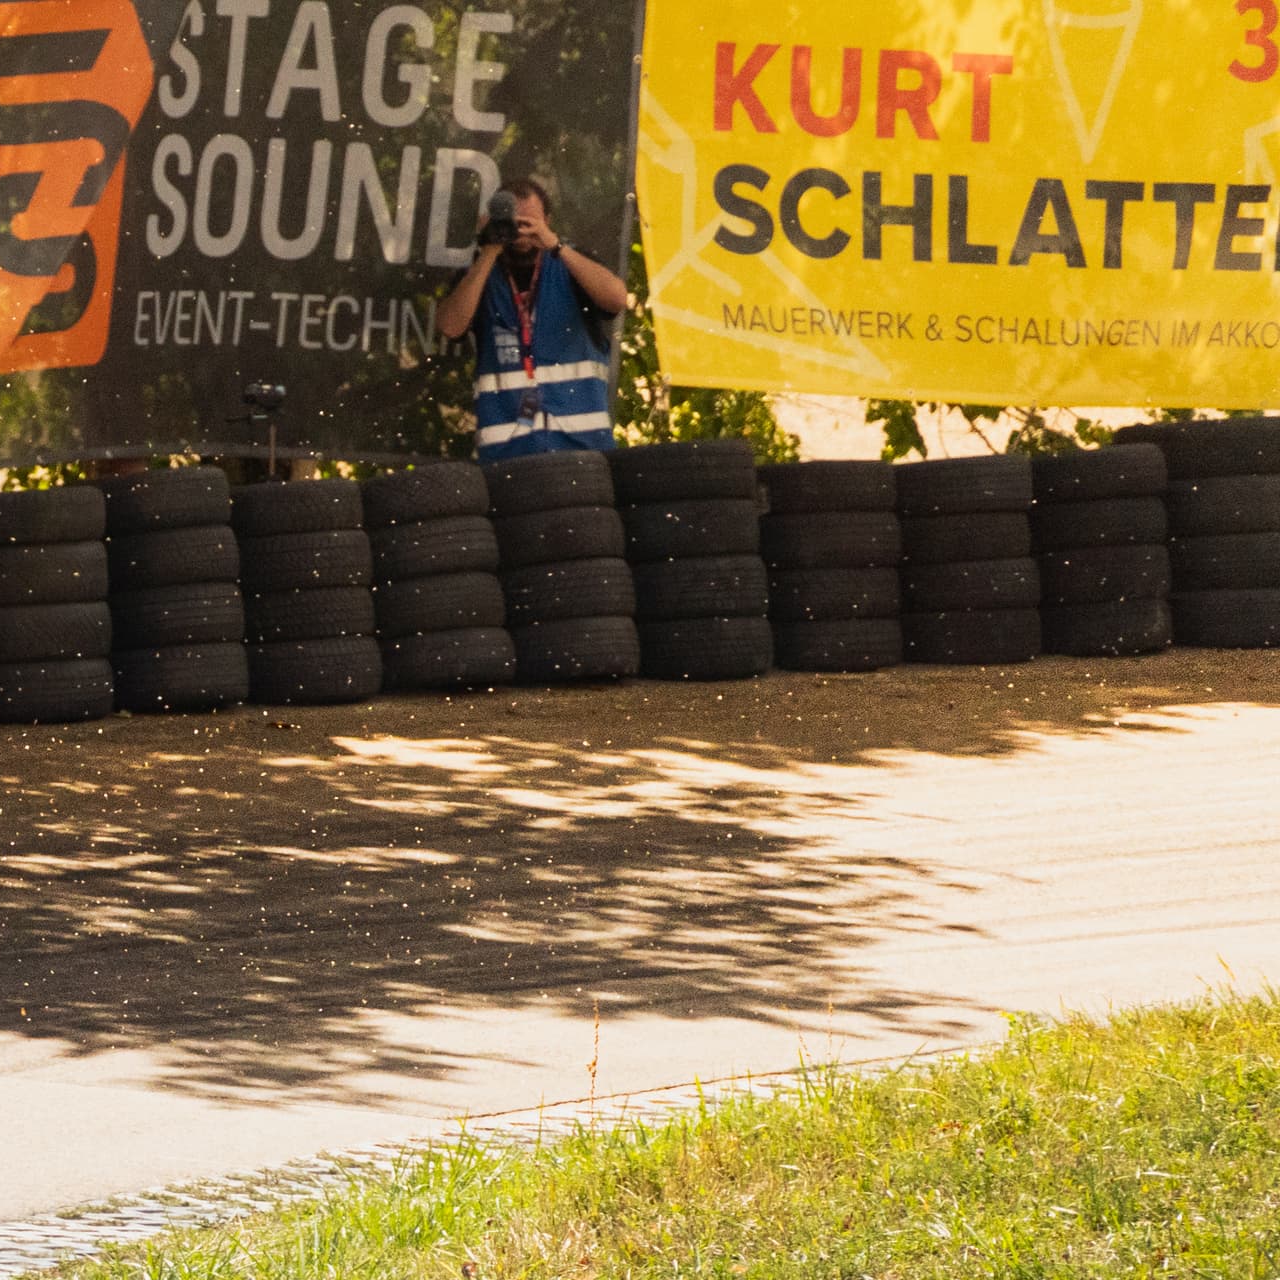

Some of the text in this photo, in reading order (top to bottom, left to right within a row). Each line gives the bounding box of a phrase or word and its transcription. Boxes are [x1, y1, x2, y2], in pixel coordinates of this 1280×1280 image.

[158, 0, 514, 131] STAGE
[712, 41, 1014, 143] KURT
[145, 133, 501, 268] SOUND
[713, 163, 1280, 273] SCHLATTE
[133, 290, 476, 358] EVENT-TECHN
[722, 304, 914, 340] MAUERWERK
[925, 314, 943, 342] &
[954, 315, 1161, 348] SCHALUNGEN
[1171, 319, 1200, 347] IM
